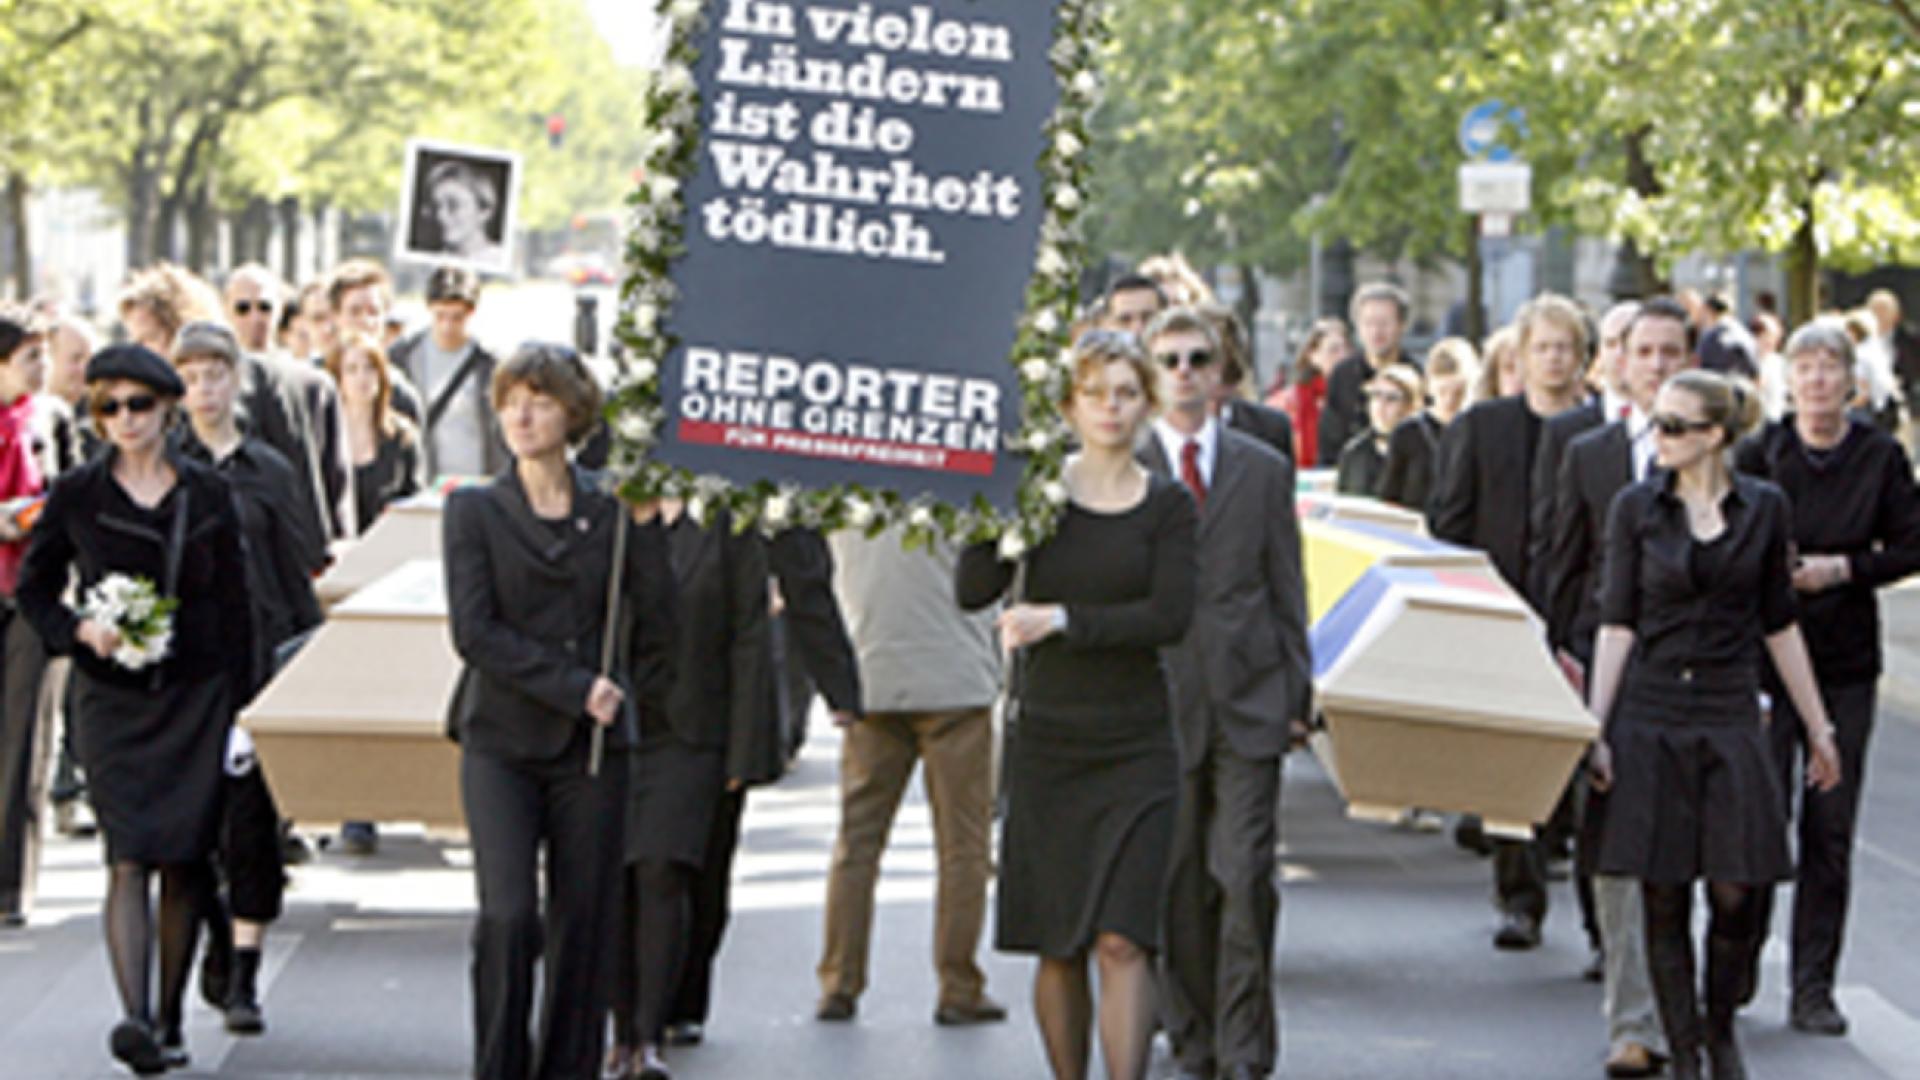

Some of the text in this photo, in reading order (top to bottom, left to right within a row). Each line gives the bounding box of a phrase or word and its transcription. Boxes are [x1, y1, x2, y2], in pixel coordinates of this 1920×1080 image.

[722, 0, 1011, 60] In vielen
[718, 40, 1002, 110] Ländern
[712, 94, 912, 151] ist die
[710, 143, 1019, 216] Wahrheit
[704, 199, 944, 262] tödlich.
[683, 348, 998, 422] REPORTER
[681, 394, 998, 453] OHNE GRENZEN
[724, 427, 768, 447] FÜR
